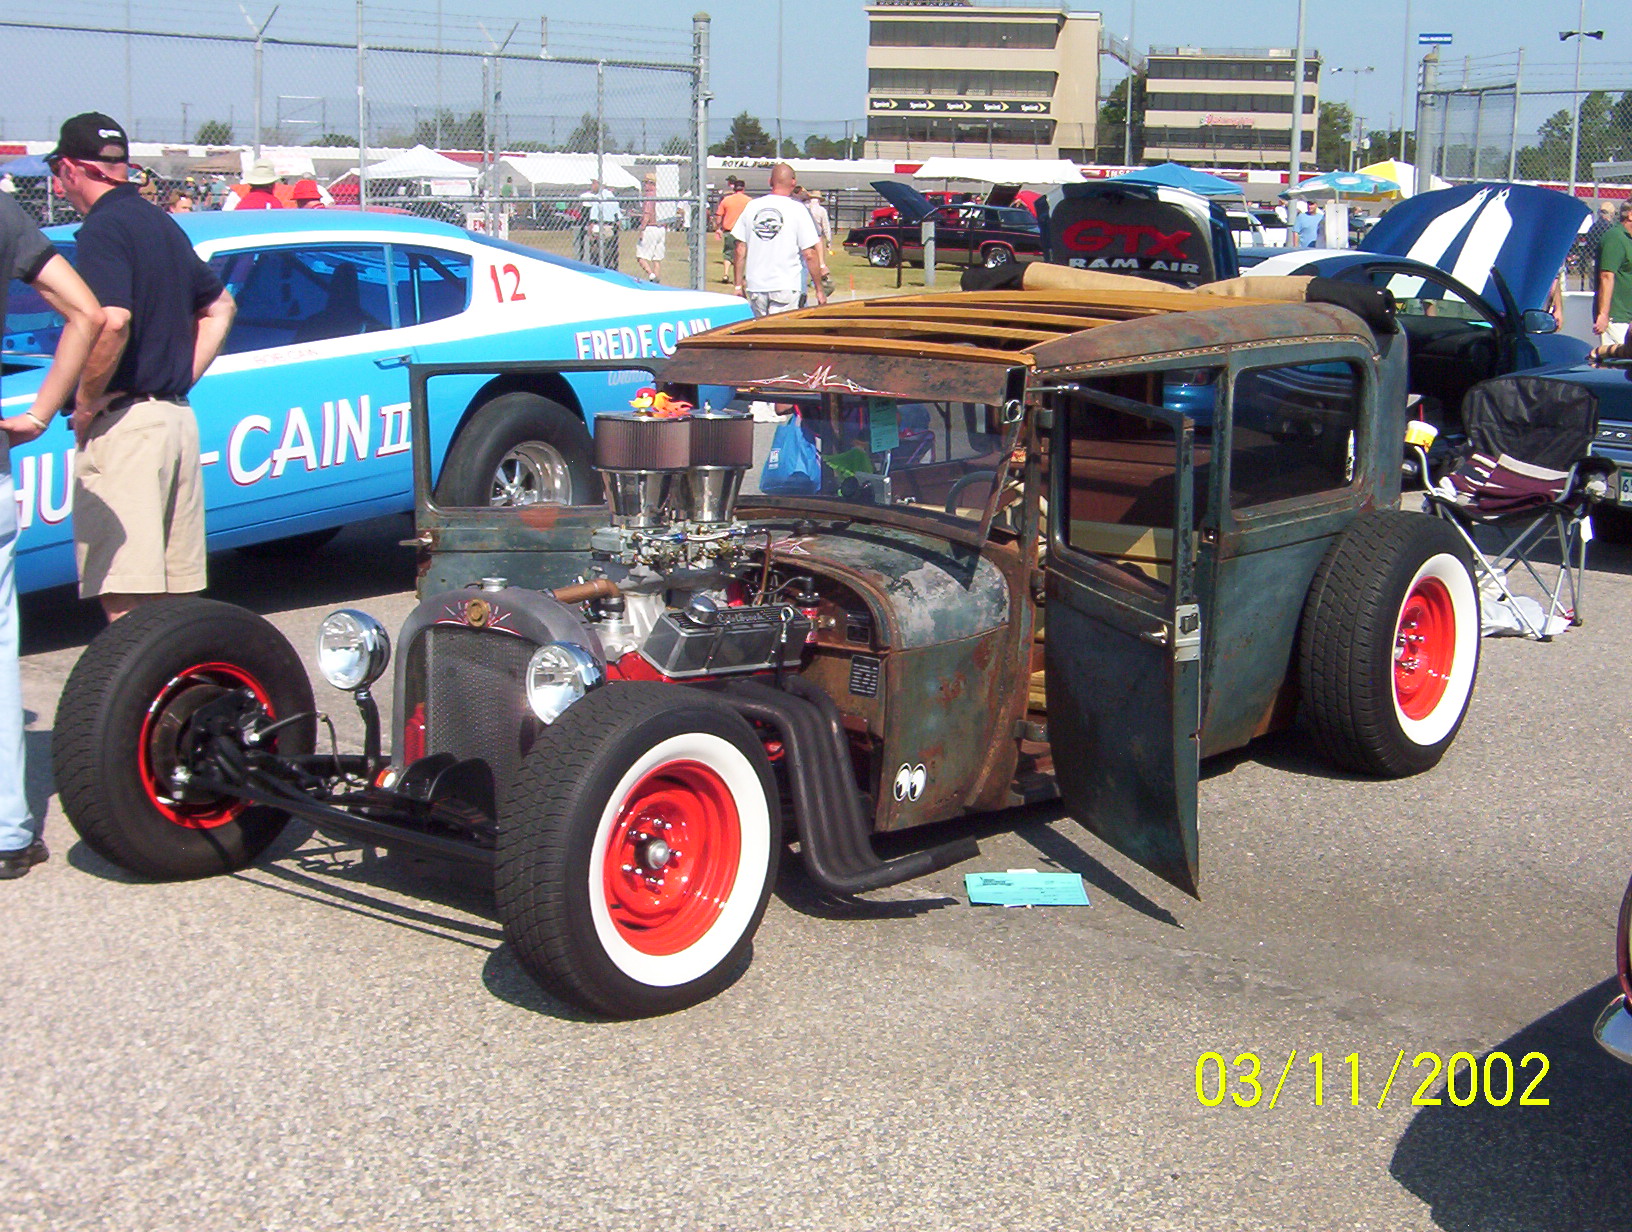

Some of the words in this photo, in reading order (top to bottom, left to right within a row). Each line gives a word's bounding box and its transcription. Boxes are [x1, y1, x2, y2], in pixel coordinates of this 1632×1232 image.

[721, 160, 749, 168] ROYAL
[1062, 219, 1192, 259] GTX
[1069, 257, 1139, 269] RAM
[1151, 259, 1200, 274] AIR
[489, 263, 526, 303] 12
[575, 326, 637, 360] FRED
